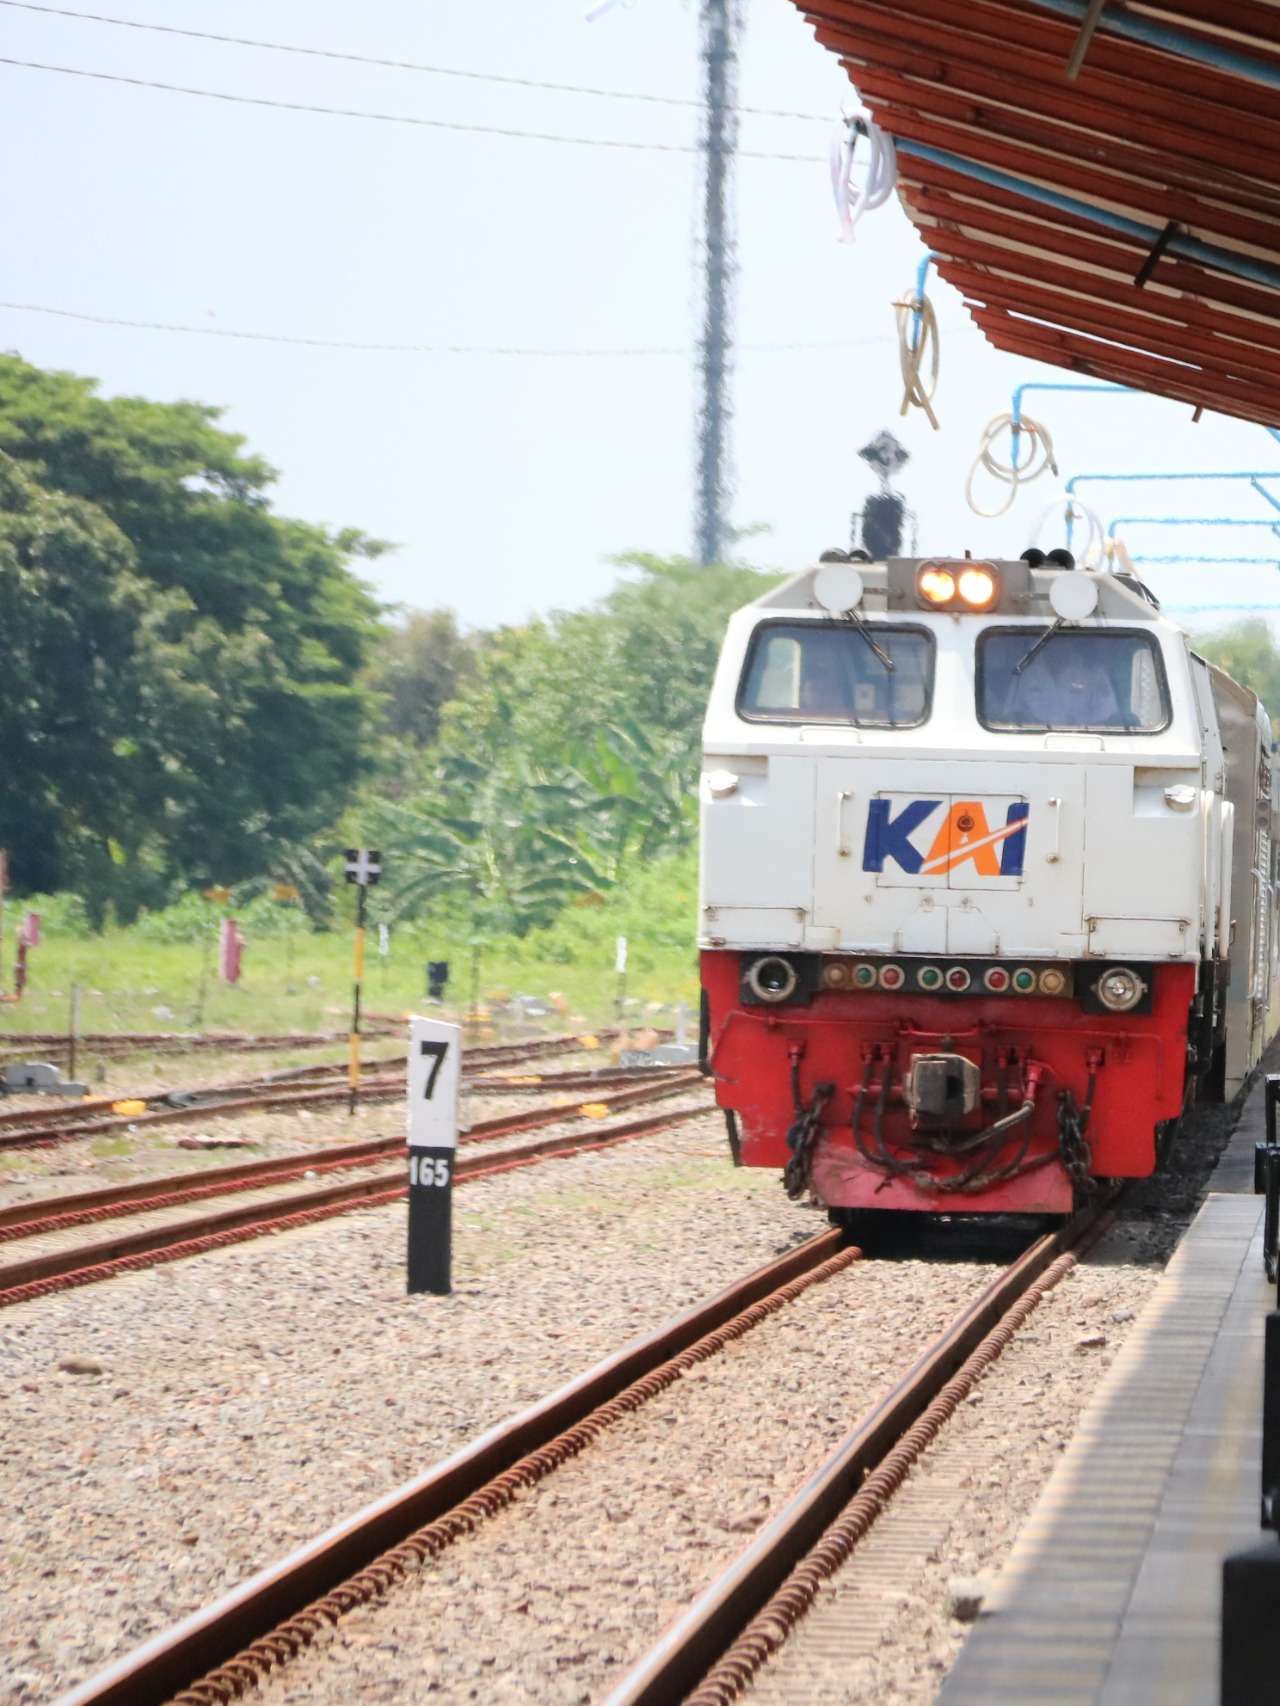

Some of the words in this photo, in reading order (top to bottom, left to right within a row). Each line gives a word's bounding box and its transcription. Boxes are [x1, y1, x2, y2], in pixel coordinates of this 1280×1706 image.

[862, 799, 1030, 876] KAI
[420, 1040, 449, 1100] 7
[410, 1156, 449, 1187] 165
